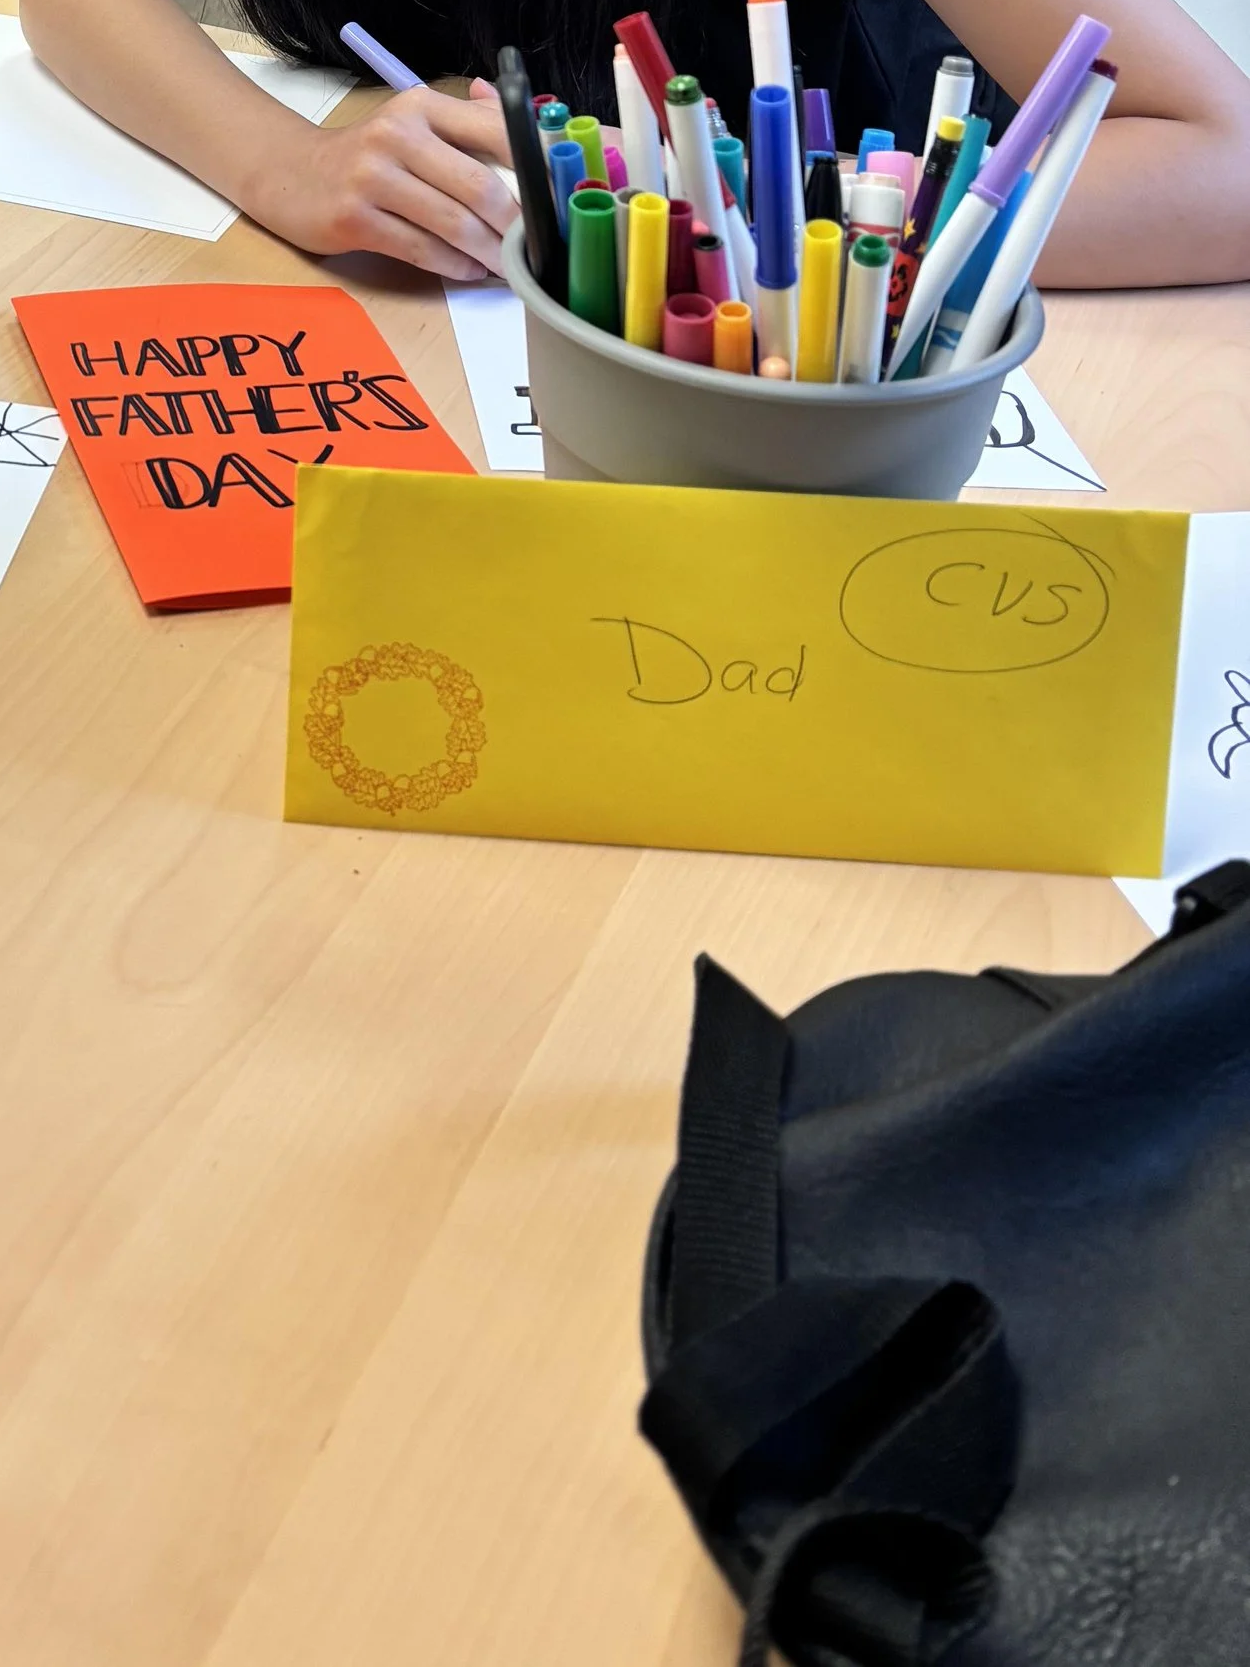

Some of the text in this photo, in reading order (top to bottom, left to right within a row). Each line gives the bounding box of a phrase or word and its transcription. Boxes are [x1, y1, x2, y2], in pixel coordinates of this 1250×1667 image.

[70, 331, 306, 378] HAPPY
[70, 370, 430, 437] FATHER'S
[926, 562, 1082, 625] CVS
[591, 616, 806, 704] Dad
